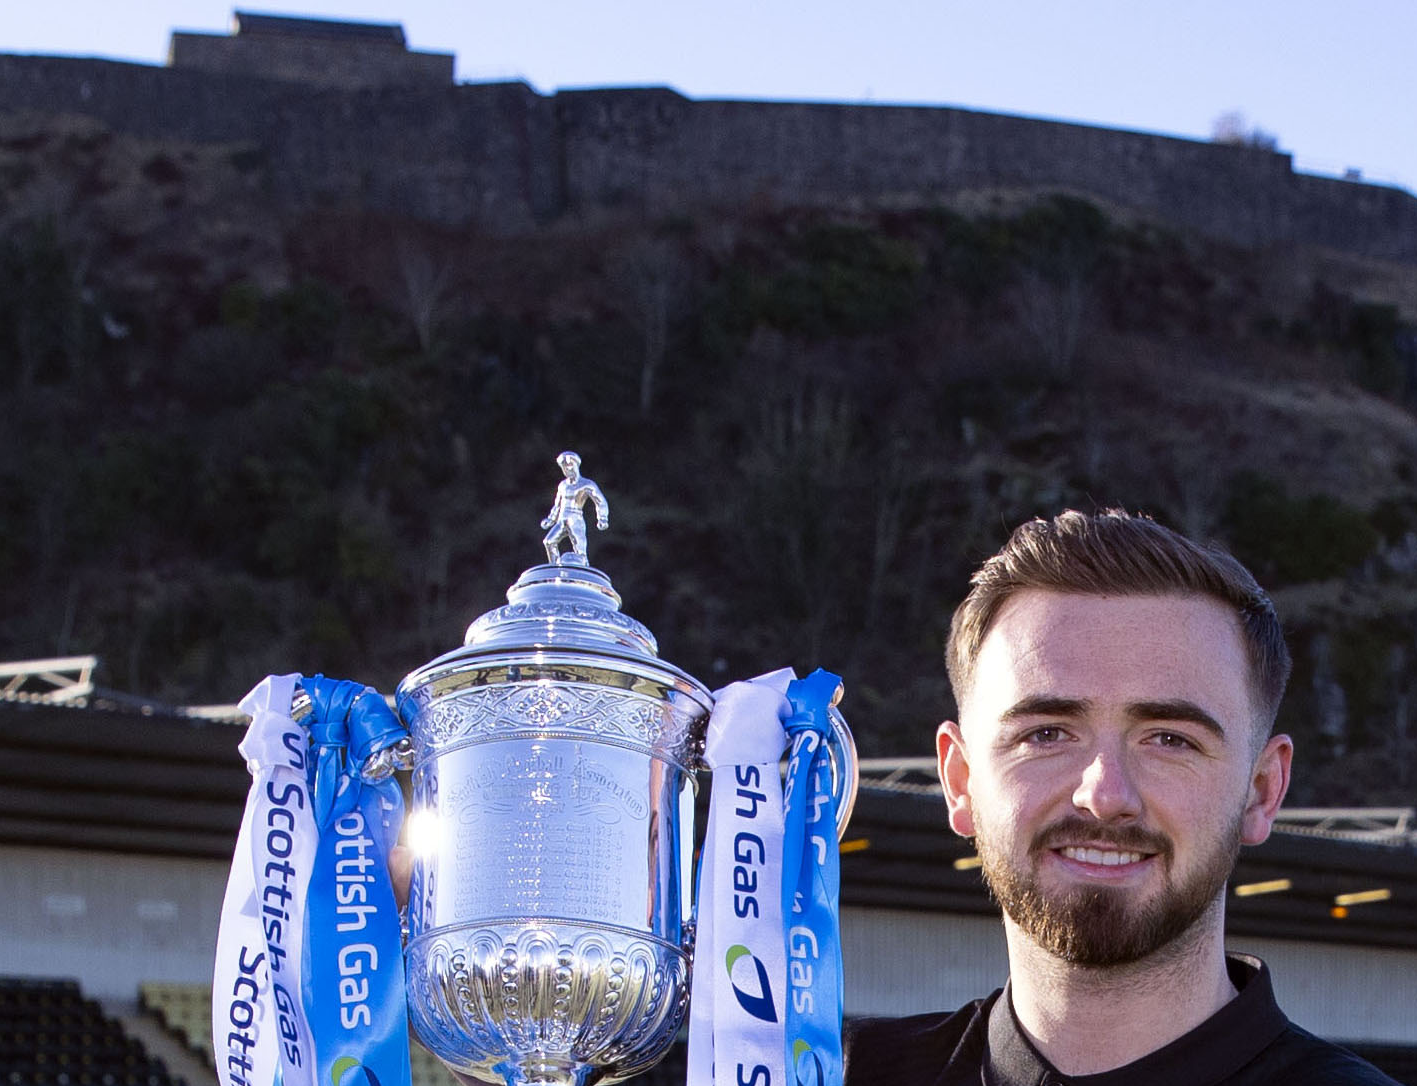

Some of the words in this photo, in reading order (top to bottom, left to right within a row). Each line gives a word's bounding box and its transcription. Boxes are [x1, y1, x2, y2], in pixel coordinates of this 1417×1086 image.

[262, 781, 304, 973] Scottish
[334, 812, 378, 932] ottish
[733, 831, 766, 919] Gas
[337, 943, 379, 1030] Gas
[789, 925, 819, 1015] Gas
[273, 982, 302, 1069] Gas
